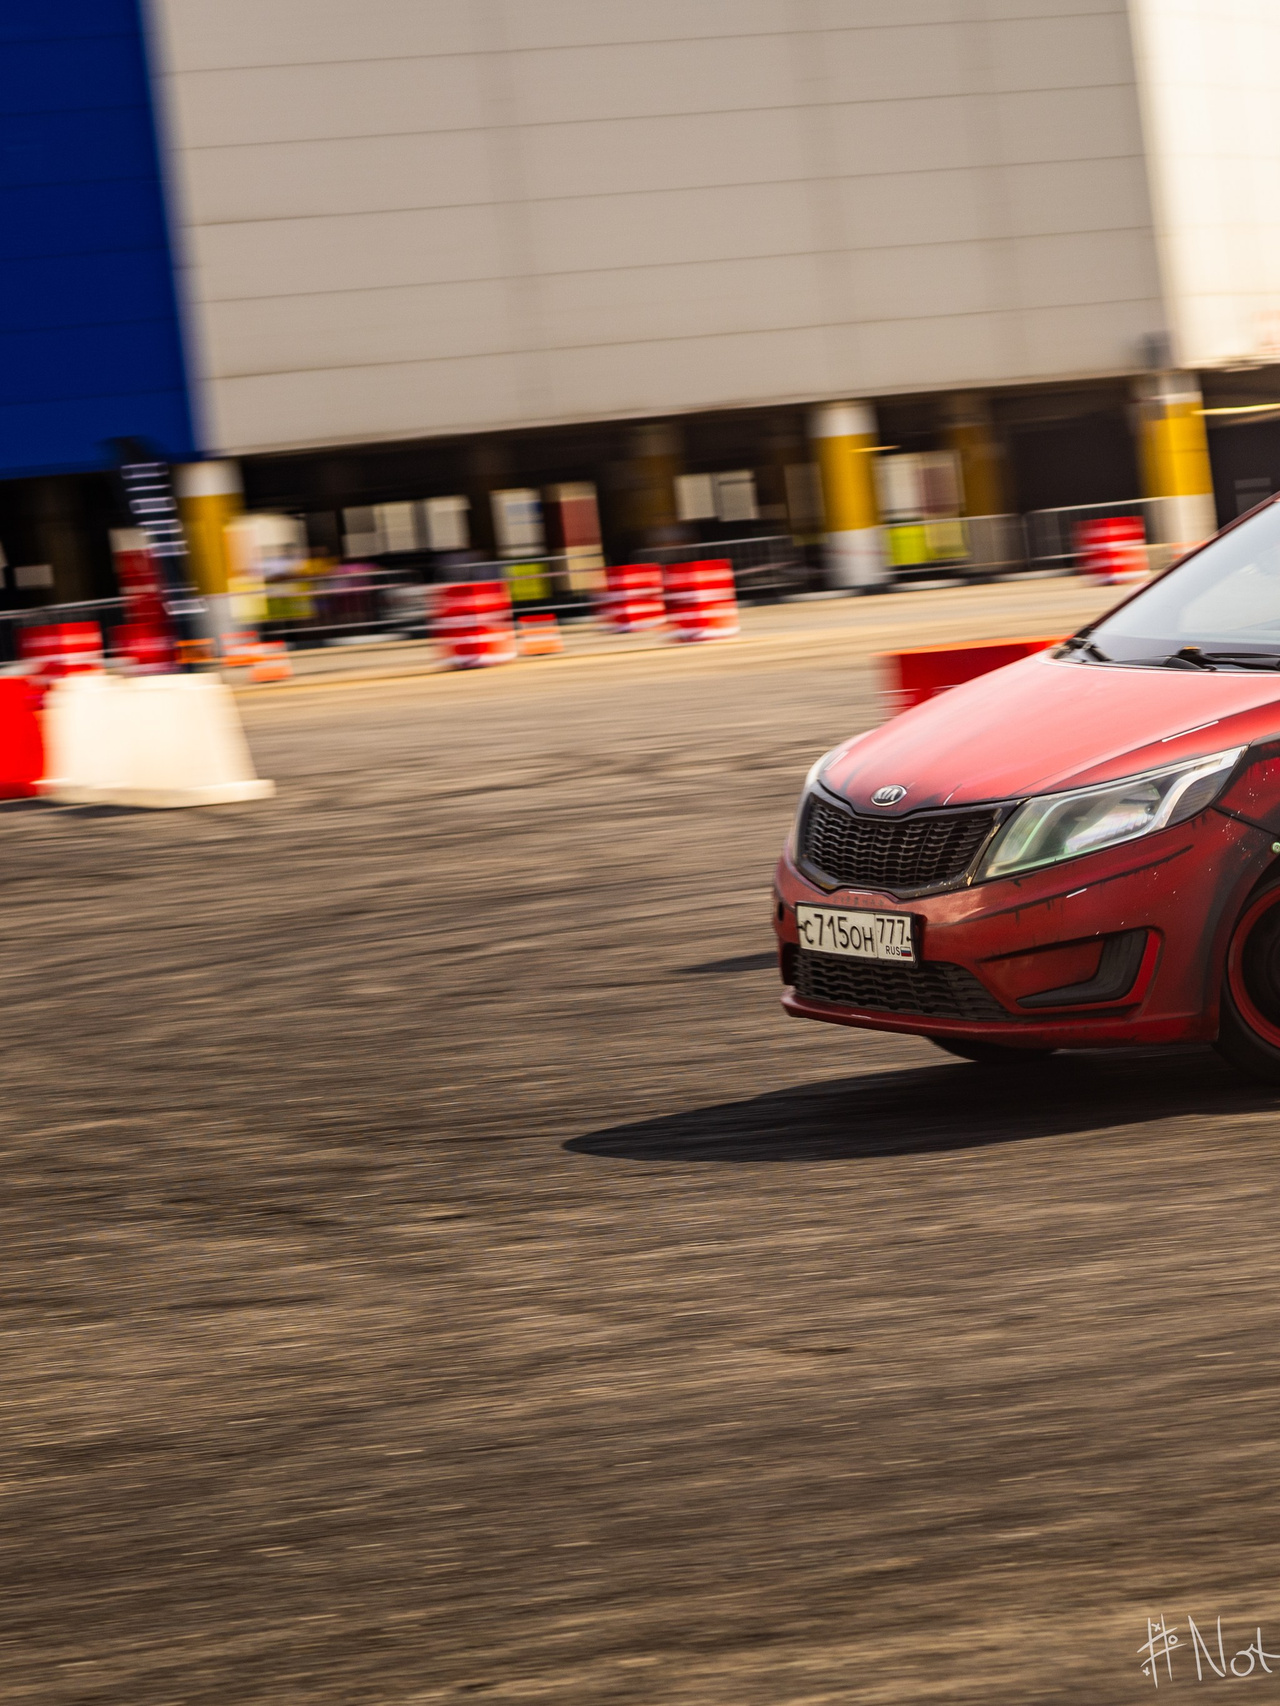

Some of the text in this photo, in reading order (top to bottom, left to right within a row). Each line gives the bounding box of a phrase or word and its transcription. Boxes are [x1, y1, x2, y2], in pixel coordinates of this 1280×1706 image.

[873, 787, 903, 803] KIA
[876, 918, 905, 945] 777
[886, 945, 901, 956] RUS
